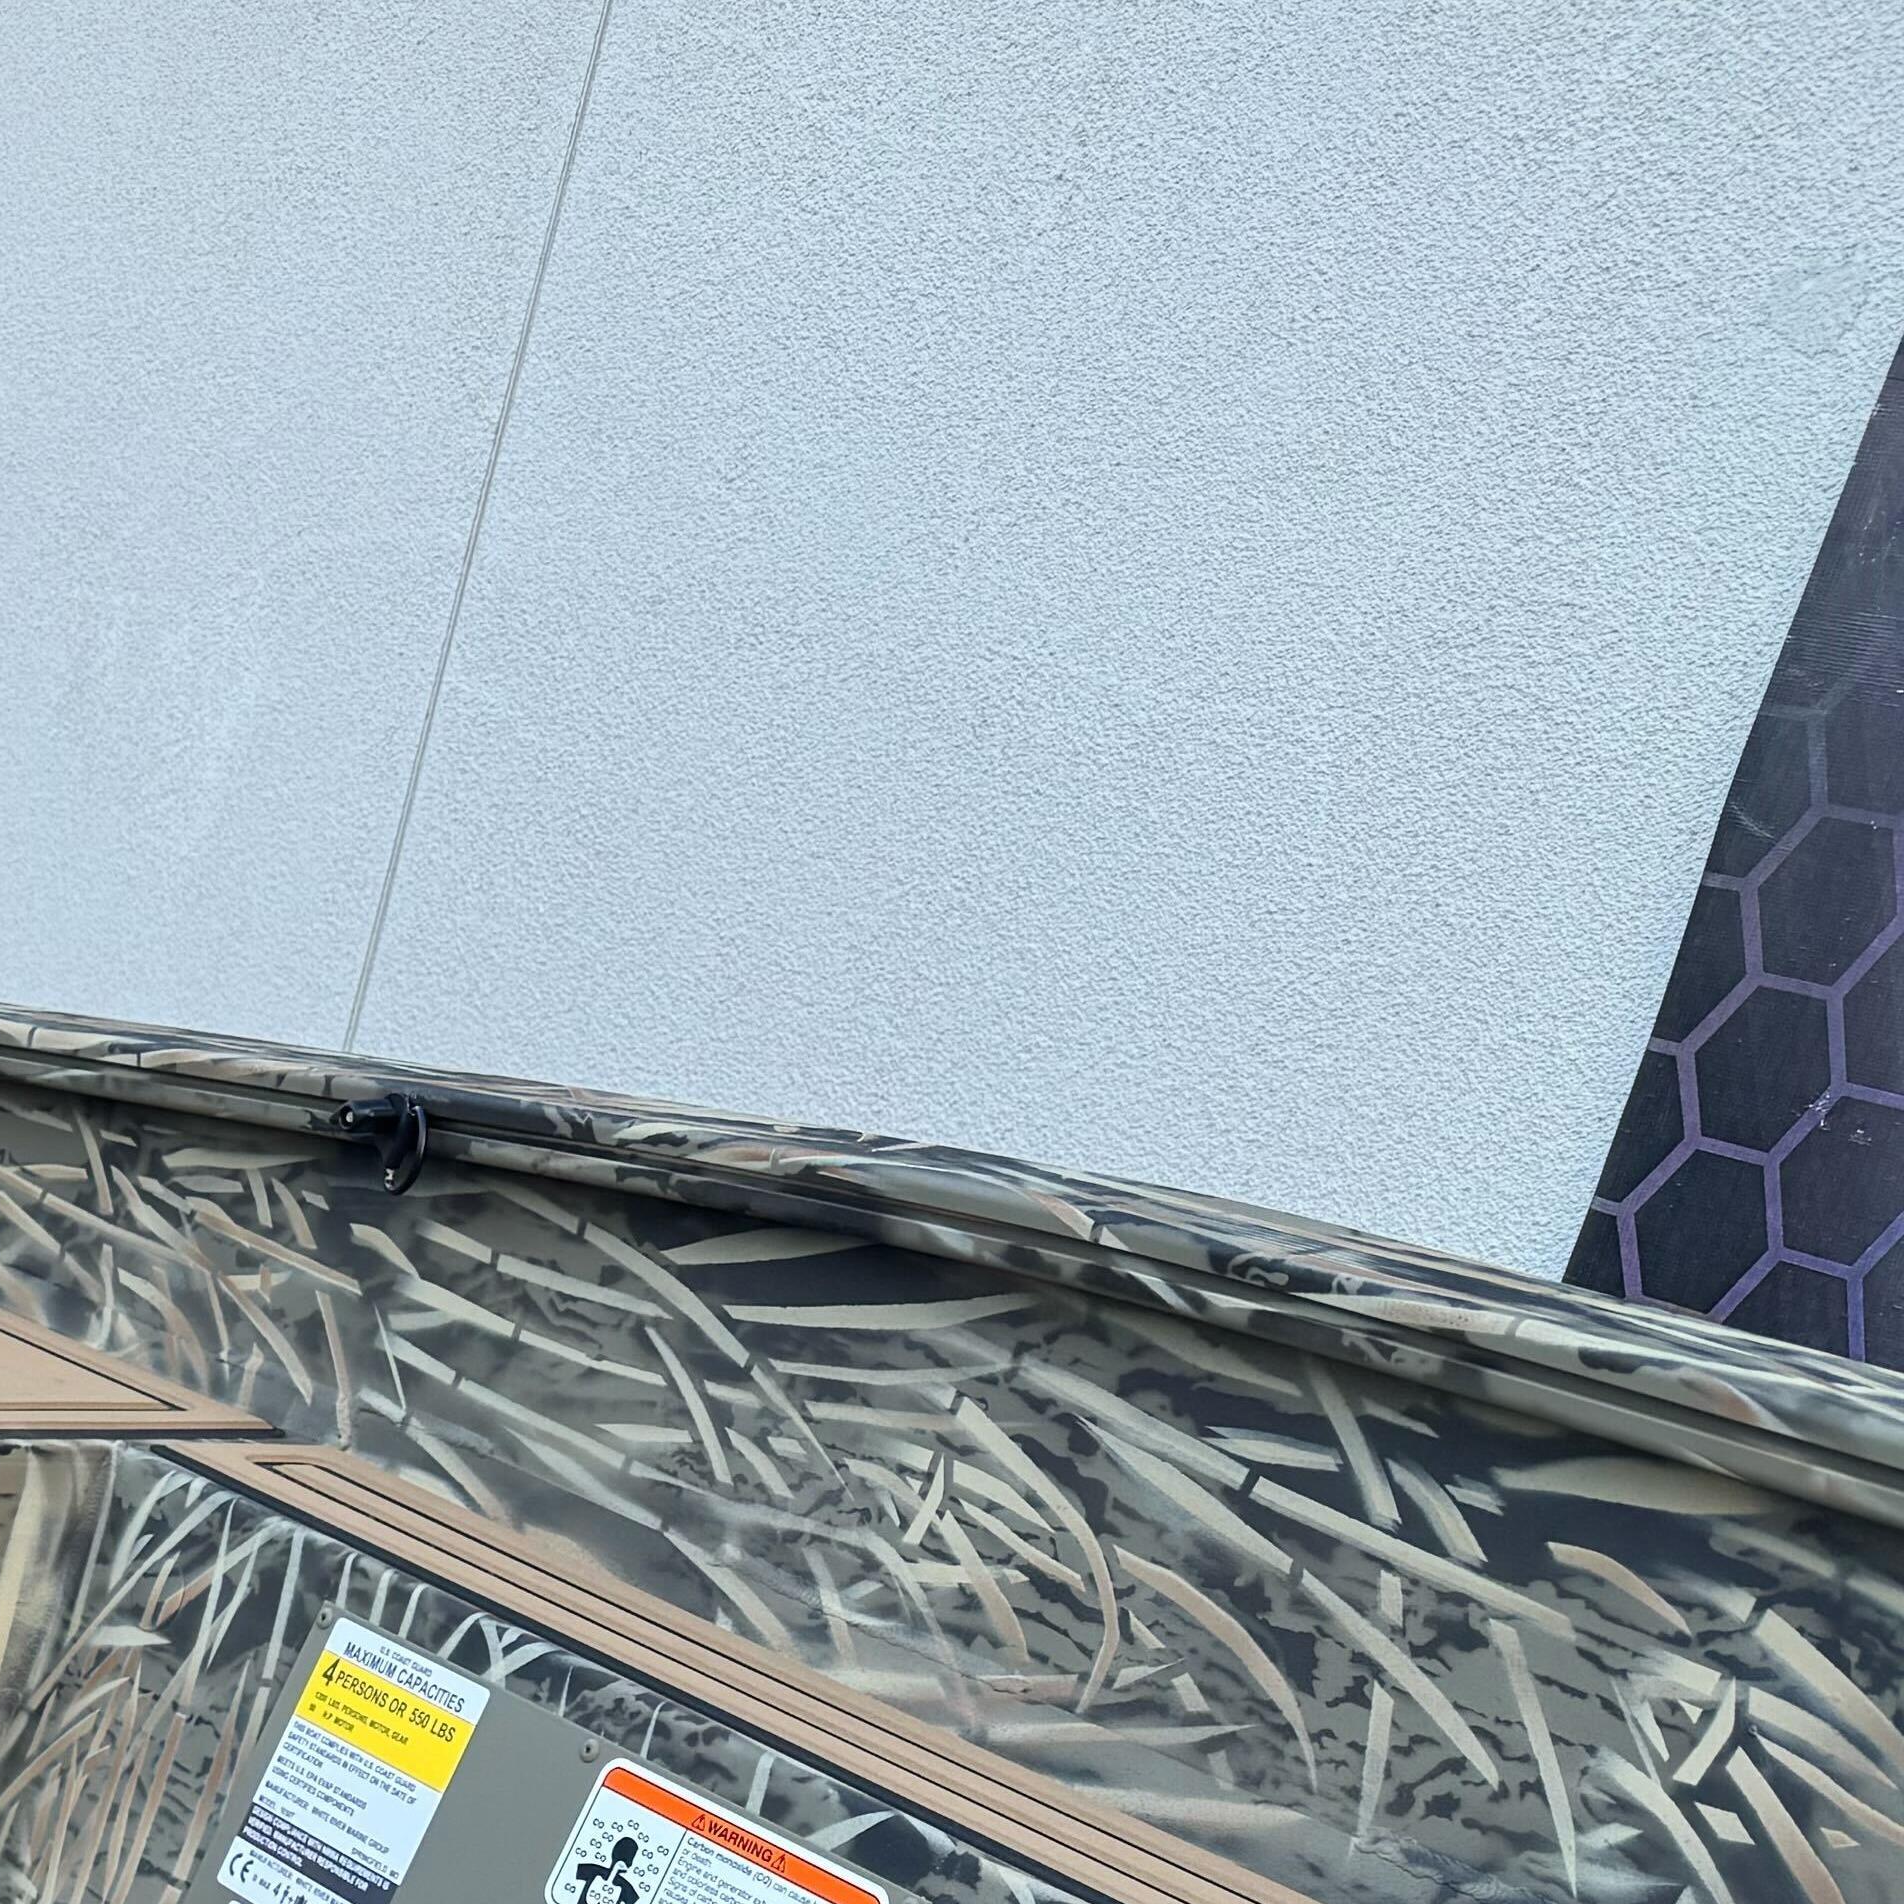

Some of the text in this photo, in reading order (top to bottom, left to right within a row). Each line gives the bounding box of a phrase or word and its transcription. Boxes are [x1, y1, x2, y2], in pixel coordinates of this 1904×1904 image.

[342, 1641, 466, 1713] MAXIMUM CAPACITIES
[319, 1653, 457, 1743] 4 PERSONS OR 550 LBS
[591, 1817, 605, 1829] CO
[610, 1820, 624, 1833] CO
[626, 1818, 640, 1831] CO
[589, 1837, 602, 1849] CO
[600, 1830, 614, 1843] CO
[636, 1831, 650, 1843] CO
[706, 1820, 774, 1863] WARNING
[574, 1846, 587, 1858] CO
[656, 1844, 670, 1856] CO
[686, 1836, 715, 1857] Carbon
[593, 1851, 607, 1863] CO
[640, 1848, 654, 1860] CO
[632, 1865, 646, 1878] CO
[646, 1863, 660, 1875] CO
[676, 1856, 703, 1877] Engine
[563, 1881, 576, 1894] CO
[637, 1880, 651, 1893] CO
